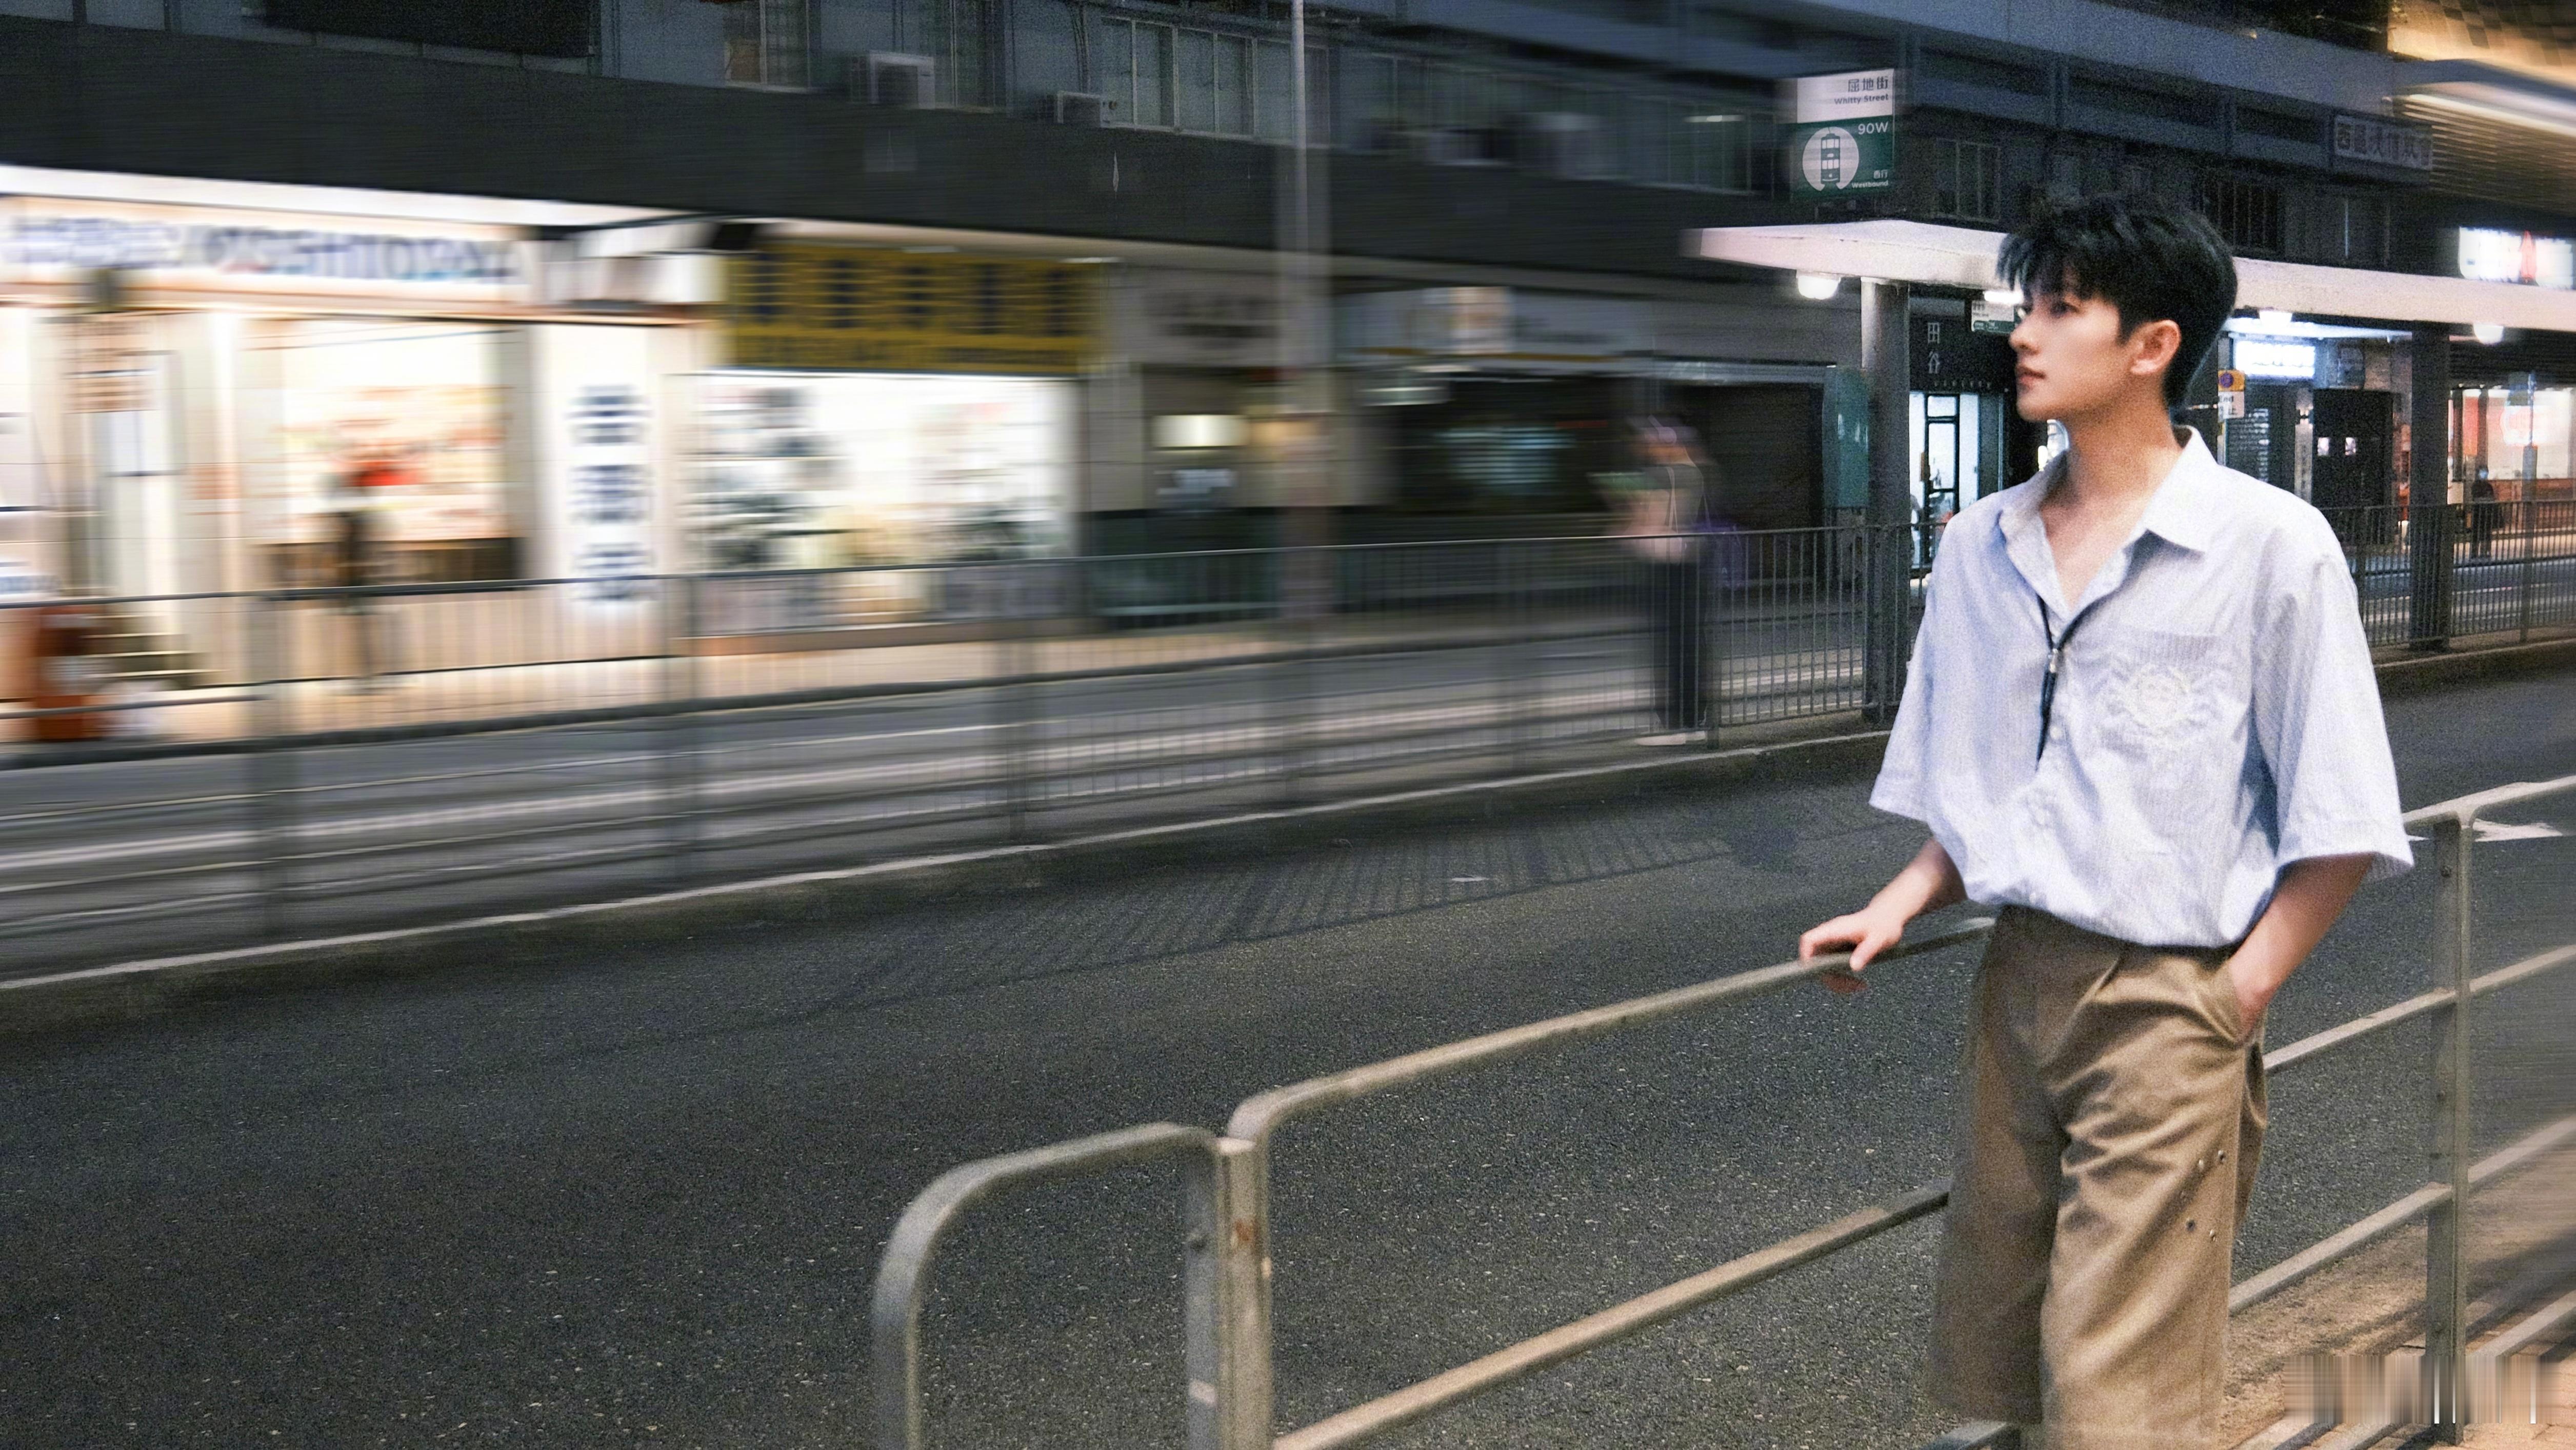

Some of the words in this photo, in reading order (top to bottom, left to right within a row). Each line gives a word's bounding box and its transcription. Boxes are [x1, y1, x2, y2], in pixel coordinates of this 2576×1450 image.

[1848, 76, 1889, 92] 屈地街
[1834, 96, 1861, 105] Whitty
[1864, 94, 1889, 102] Street
[1858, 122, 1889, 135] 90W
[1851, 180, 1888, 188] Westbound
